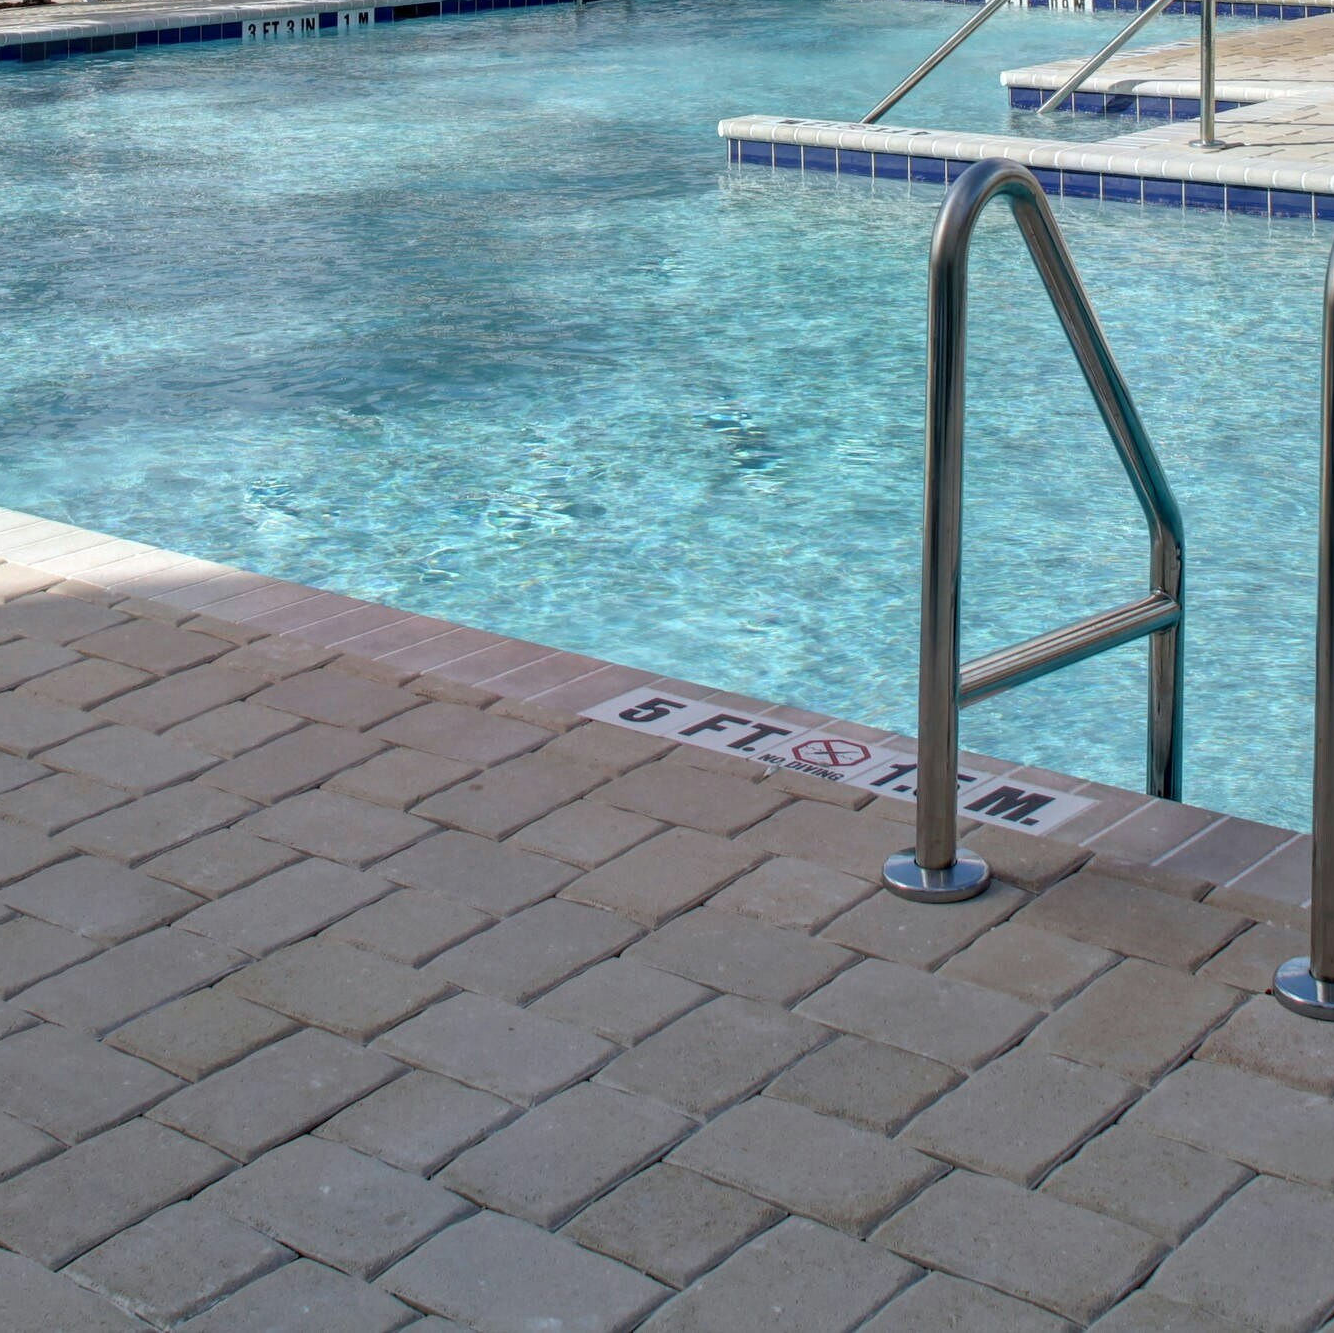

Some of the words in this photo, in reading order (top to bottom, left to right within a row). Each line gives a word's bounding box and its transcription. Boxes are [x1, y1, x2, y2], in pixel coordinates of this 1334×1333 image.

[618, 697, 687, 723] 5
[677, 713, 793, 752] FT.
[964, 785, 1057, 827] M.
[758, 753, 786, 764] NO
[785, 761, 845, 781] DIVING
